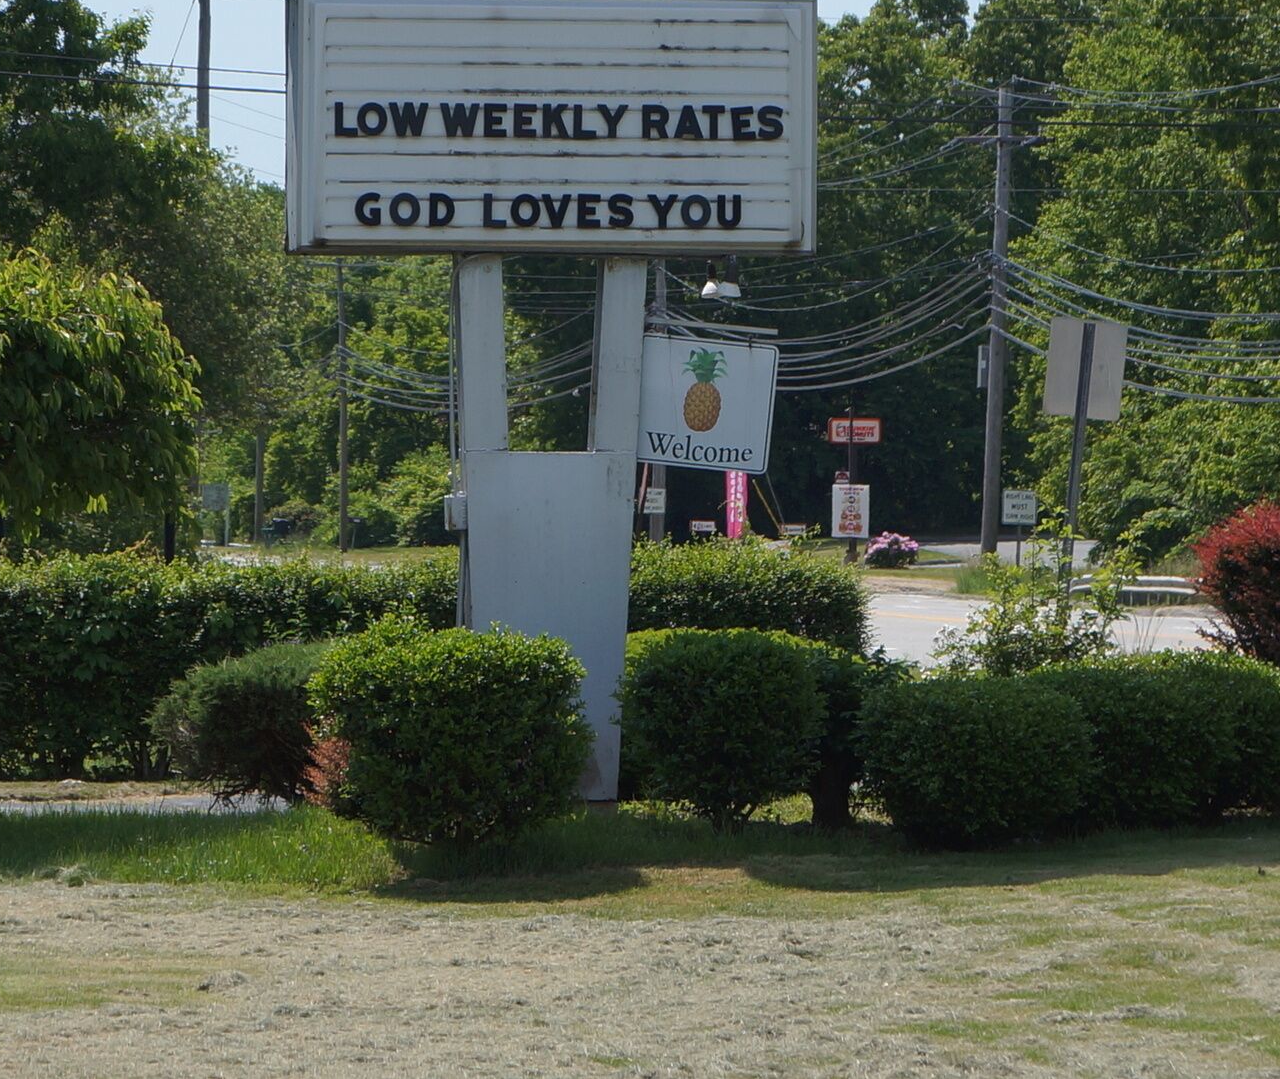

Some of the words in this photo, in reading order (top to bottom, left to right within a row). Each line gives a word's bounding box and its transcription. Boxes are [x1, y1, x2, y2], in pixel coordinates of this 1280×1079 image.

[334, 101, 429, 139] LOW
[439, 102, 630, 140] WEEKLY
[640, 104, 785, 142] RATES
[354, 192, 456, 228] GOD
[482, 193, 634, 229] LOVES
[646, 194, 743, 229] YOU
[645, 431, 754, 464] Welcome
